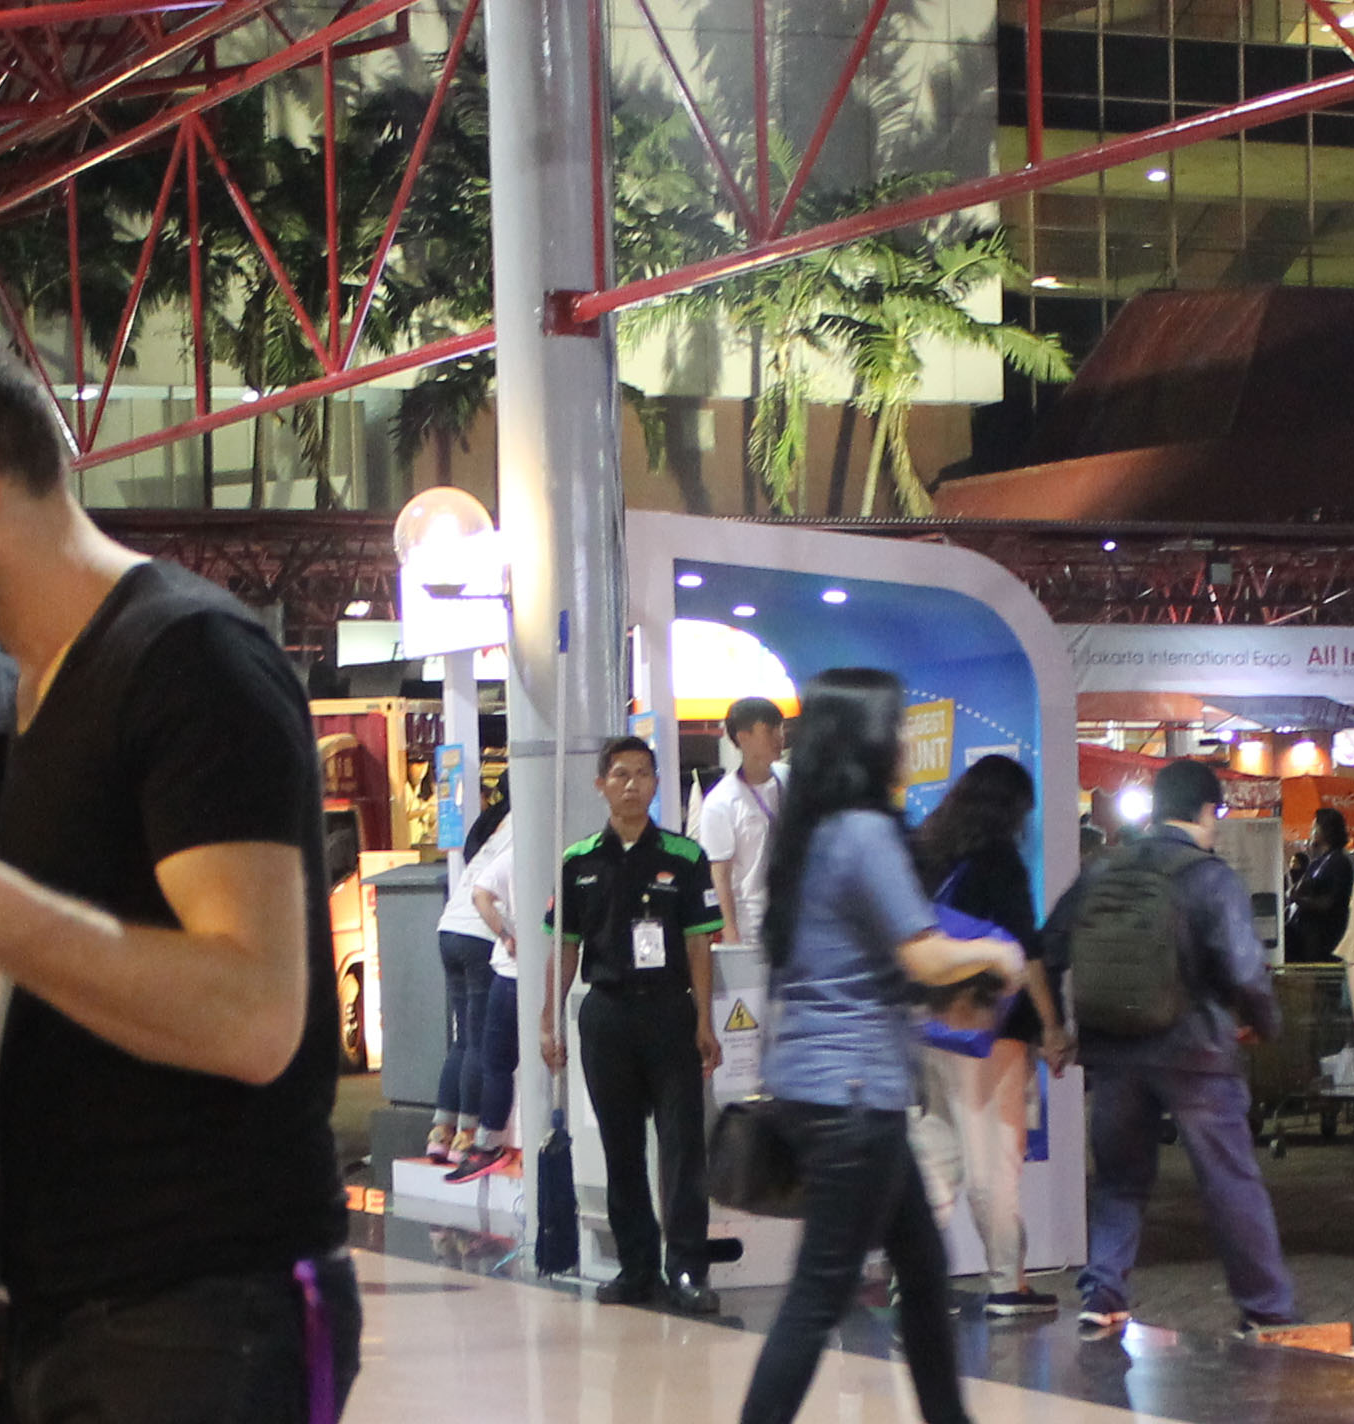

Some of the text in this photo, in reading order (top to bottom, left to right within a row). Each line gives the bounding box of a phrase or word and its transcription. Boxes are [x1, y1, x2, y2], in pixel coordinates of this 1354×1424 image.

[1149, 650, 1250, 667] International
[1254, 651, 1292, 668] Expo
[1307, 646, 1336, 666] All
